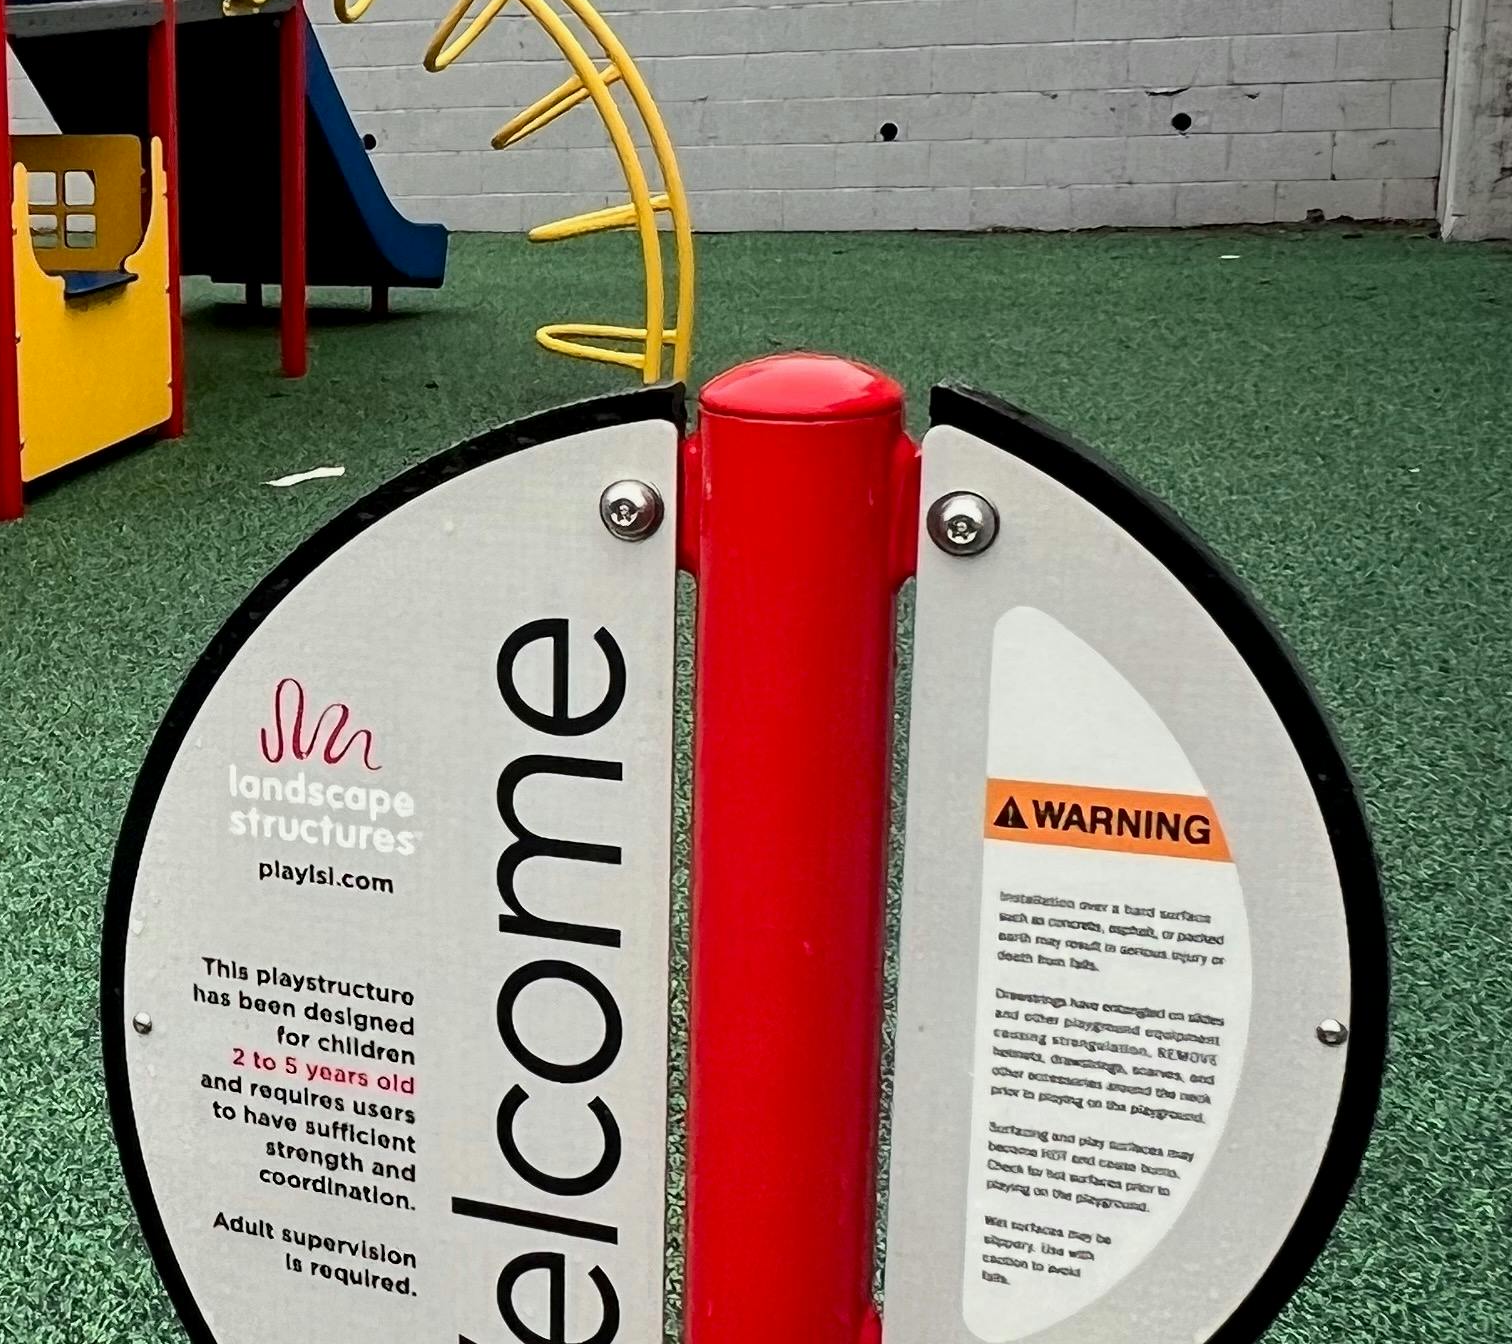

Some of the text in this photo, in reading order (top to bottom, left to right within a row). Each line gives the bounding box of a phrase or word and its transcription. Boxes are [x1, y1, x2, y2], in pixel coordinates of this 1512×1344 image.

[229, 762, 416, 822] landscape
[228, 807, 417, 856] structures
[1032, 799, 1211, 845] WARNING
[201, 956, 415, 1007] This playstructure
[193, 983, 415, 1036] has been designed
[277, 1025, 415, 1066] for children
[232, 1047, 415, 1095] 2 to 5 years old
[200, 1073, 416, 1125] and requires users
[212, 1100, 417, 1154] to have sufficient
[265, 1141, 416, 1183] strength and
[259, 1169, 416, 1211] coordination.
[212, 1211, 417, 1269] Adult supervision
[285, 1252, 417, 1297] is required.
